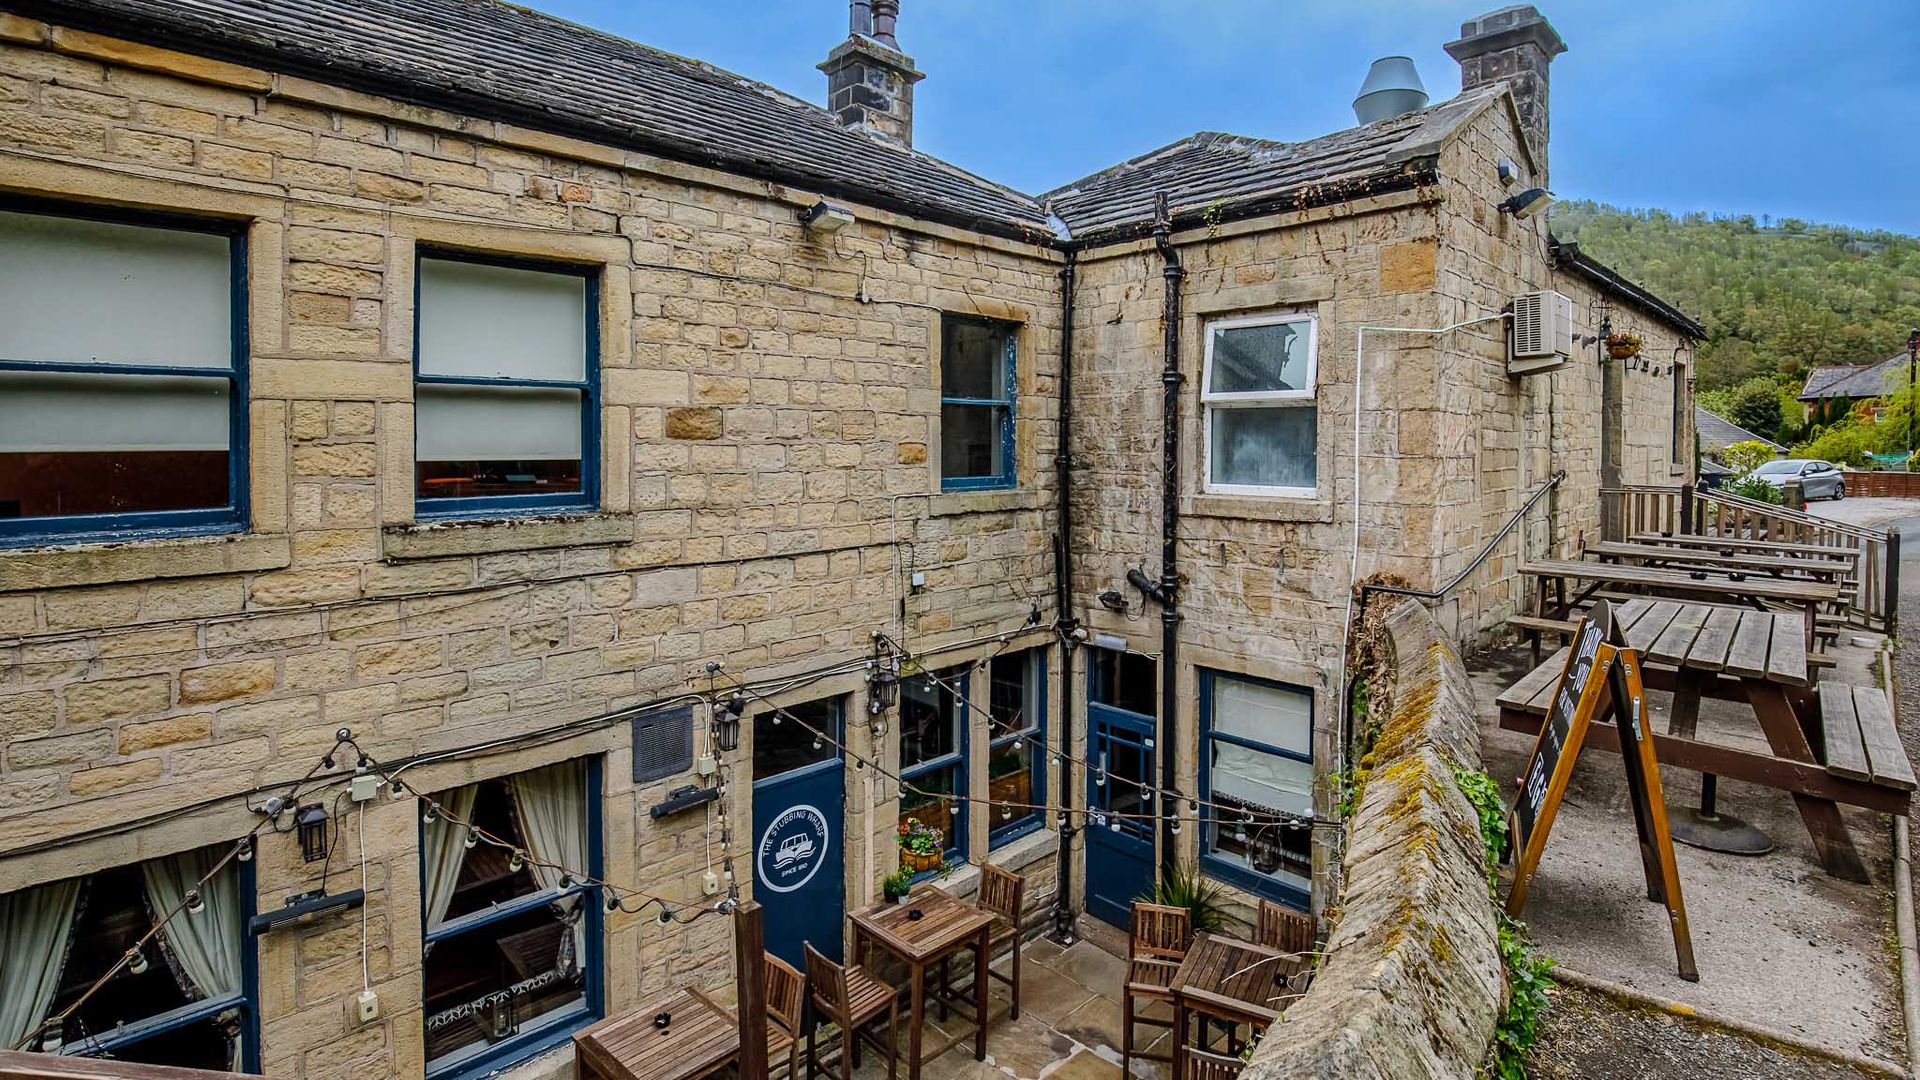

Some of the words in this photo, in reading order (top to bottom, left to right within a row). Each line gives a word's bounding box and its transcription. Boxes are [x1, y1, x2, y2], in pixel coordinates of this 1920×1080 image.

[763, 839, 773, 857] THE
[771, 811, 806, 837] STUBBING
[807, 813, 824, 837] WHARF
[781, 866, 796, 877] SINCE
